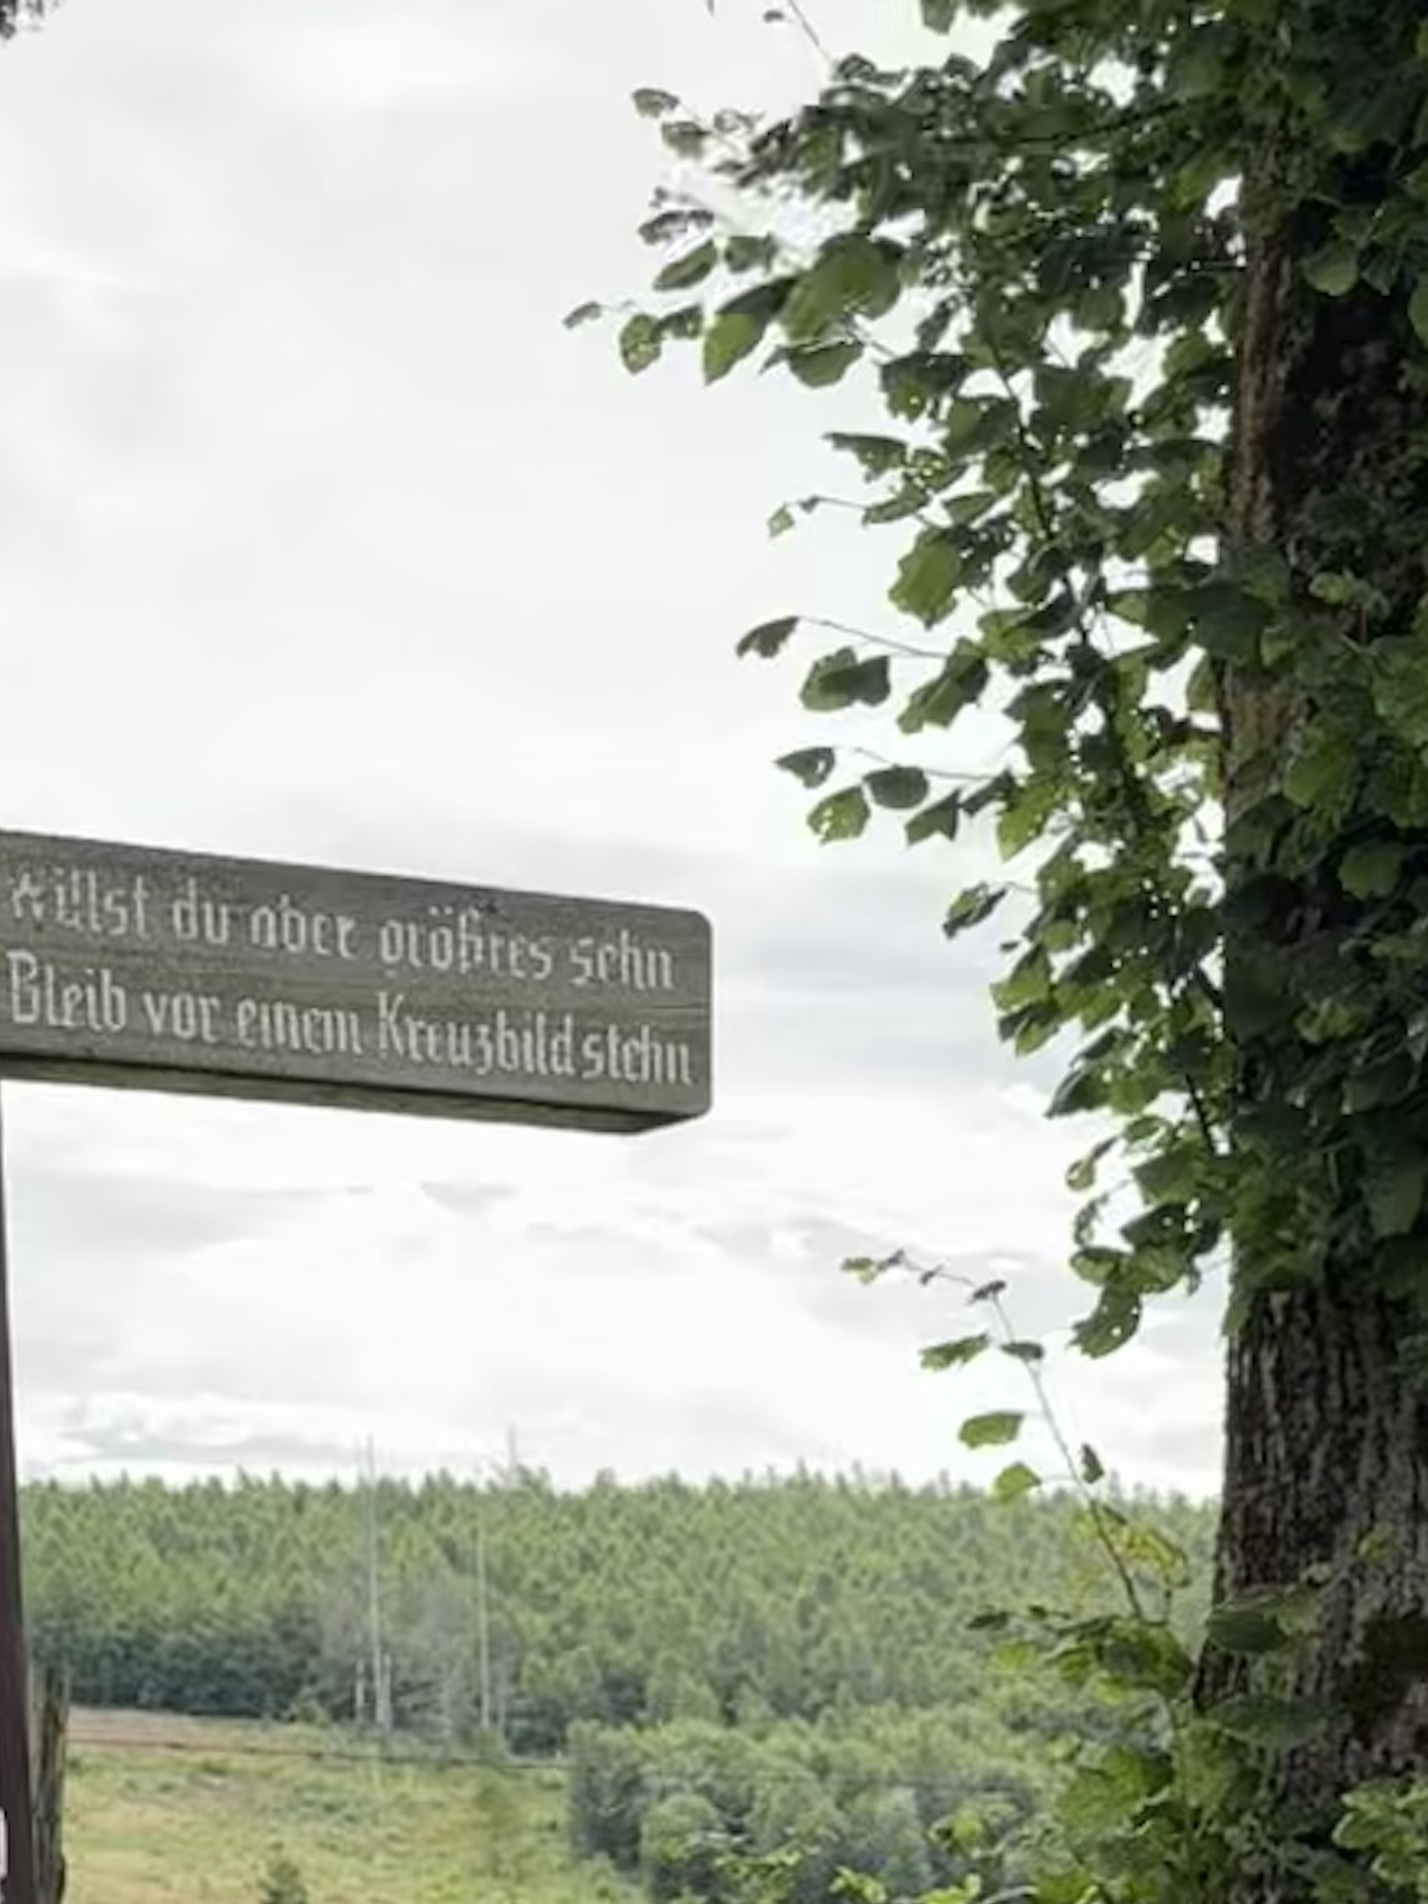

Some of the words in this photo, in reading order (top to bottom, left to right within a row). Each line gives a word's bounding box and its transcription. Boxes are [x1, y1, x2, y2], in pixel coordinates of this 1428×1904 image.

[172, 877, 230, 945] du
[6, 948, 128, 1034] Bleib
[142, 990, 222, 1044] vor
[236, 998, 365, 1056] einem
